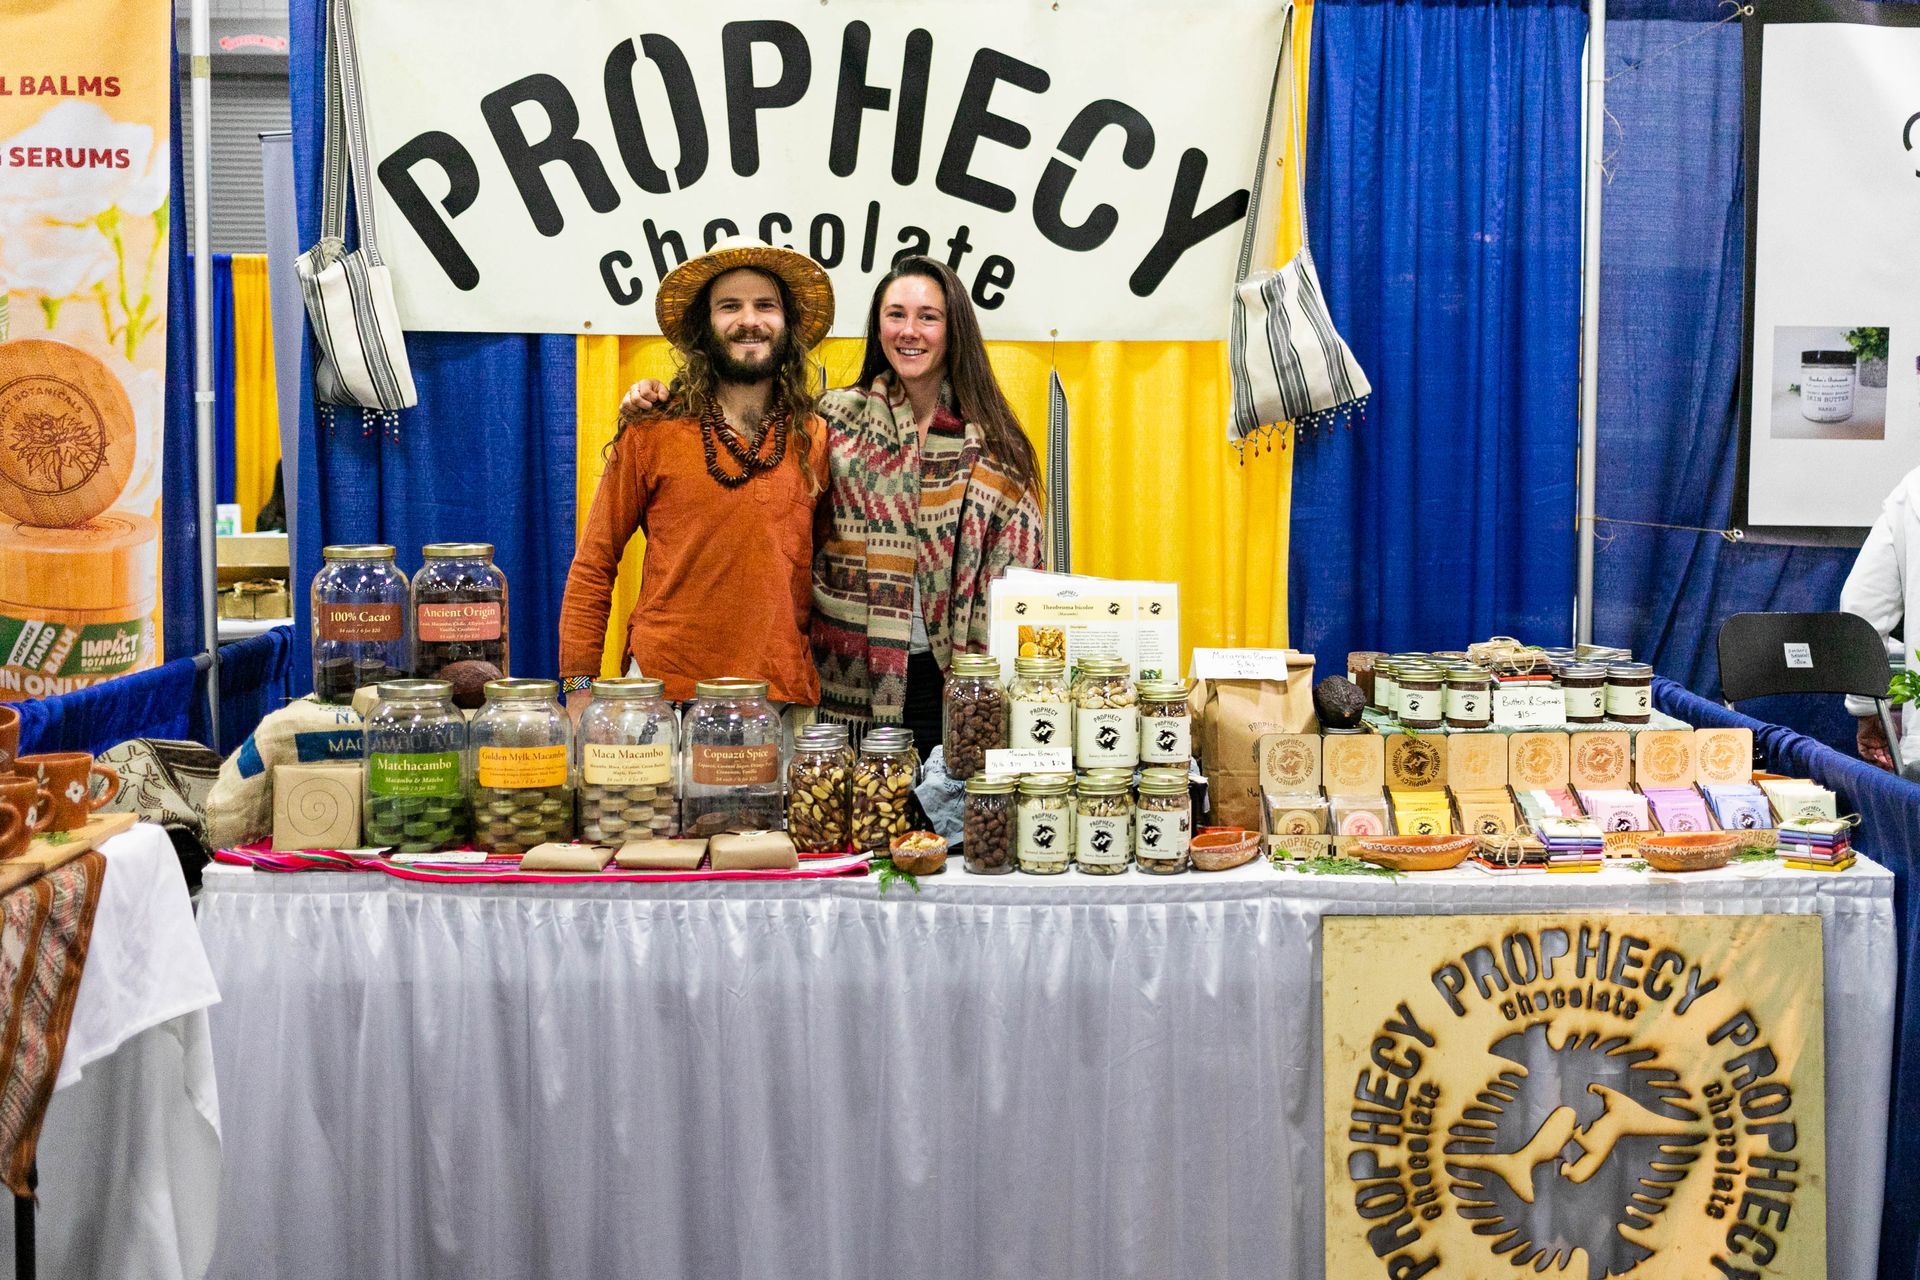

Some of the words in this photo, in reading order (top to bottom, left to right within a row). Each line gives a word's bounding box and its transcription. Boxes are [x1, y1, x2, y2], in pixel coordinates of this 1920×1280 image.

[20, 75, 121, 97] BALMS
[9, 147, 130, 169] SERUMS
[377, 20, 1251, 297] PROPHECY
[330, 611, 356, 622] 100%
[359, 610, 391, 622] Cacao
[424, 607, 461, 618] Ancient
[464, 606, 496, 620] Origin
[27, 626, 56, 669] HAND
[81, 634, 139, 658] IMPACT
[1529, 696, 1534, 706] &
[1030, 707, 1058, 717] PROPHECY
[1094, 713, 1122, 723] PROPHECY
[1155, 720, 1179, 728] PROPHECY
[1248, 721, 1286, 733] PROPHECY
[1276, 738, 1307, 748] PROPHECY
[1586, 736, 1616, 746] PROPHECY
[482, 752, 507, 760] Golden
[510, 752, 530, 762] Mylk
[532, 750, 566, 760] Macambo
[592, 748, 615, 758] Maca
[618, 748, 663, 759] Macambo
[704, 748, 744, 761] Copuazú
[747, 748, 768, 760] Spice
[377, 758, 451, 771] Matchacambo
[1431, 748, 1440, 778] PROPHECY
[1032, 813, 1058, 821] PROPHECY
[1141, 813, 1164, 823] PROPHECY
[1090, 820, 1116, 828] PROPHECY
[1274, 836, 1326, 853] PROPHECY
[1431, 926, 1719, 1017] PROPHECY
[1500, 983, 1639, 1021] chocolate
[1348, 1001, 1440, 1280] PROPHECY
[1707, 1010, 1799, 1280] PROPHECY
[1405, 1082, 1443, 1220] chocolate
[1702, 1080, 1738, 1220] chocolate
